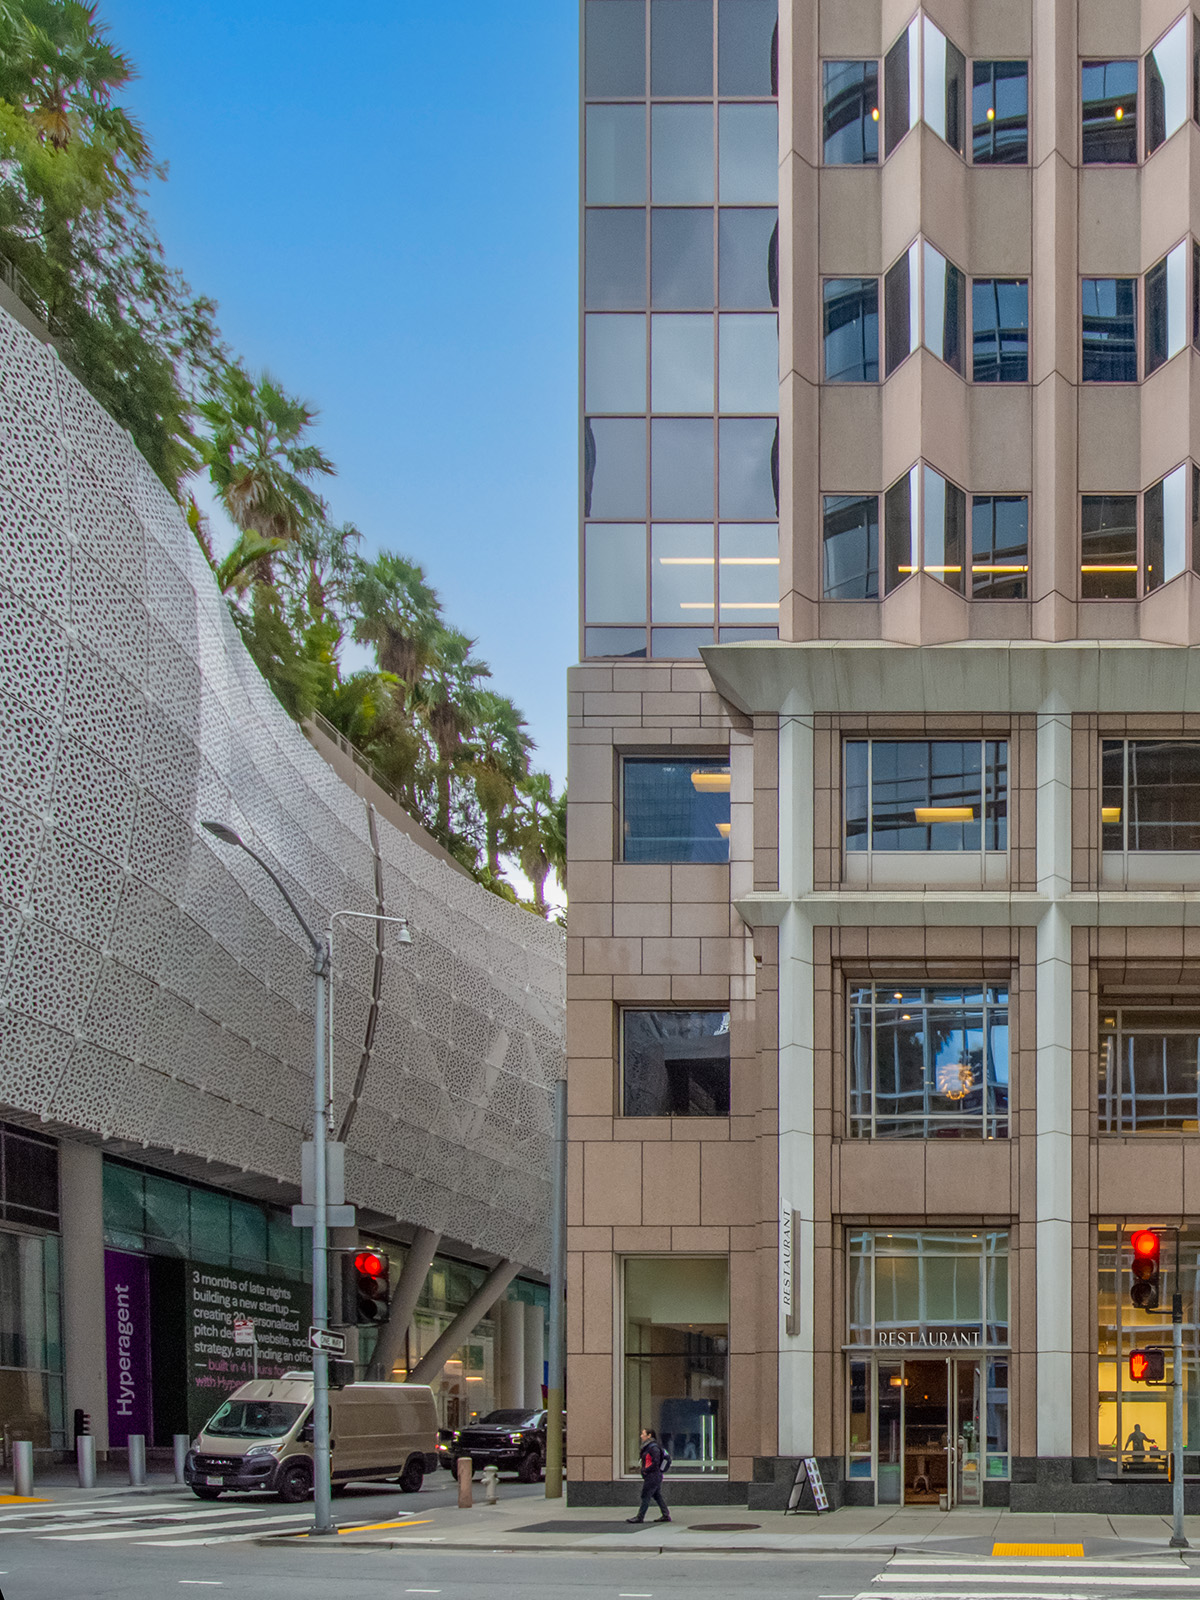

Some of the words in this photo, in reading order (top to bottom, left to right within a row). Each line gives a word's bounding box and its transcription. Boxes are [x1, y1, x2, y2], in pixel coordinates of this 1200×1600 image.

[783, 1209, 791, 1306] RESTAURANT
[192, 1270, 200, 1283] 3
[201, 1274, 238, 1290] months
[238, 1280, 249, 1292] of
[249, 1281, 266, 1295] late
[266, 1285, 292, 1300] nights
[193, 1288, 231, 1308] building
[232, 1298, 238, 1307] a
[239, 1299, 258, 1310] new
[258, 1300, 290, 1316] startup
[193, 1308, 232, 1325] creating
[194, 1323, 219, 1338] pitch
[257, 1332, 291, 1347] website,
[292, 1337, 309, 1347] soci
[320, 1335, 331, 1346] ONE
[879, 1332, 980, 1347] RESTAURANT
[115, 1284, 135, 1416] Hyperagent
[194, 1343, 234, 1358] strategy,
[235, 1346, 253, 1357] and
[283, 1353, 294, 1362] an
[294, 1352, 314, 1363] offic
[208, 1358, 229, 1371] built
[229, 1360, 239, 1372] in
[240, 1361, 246, 1372] 4
[248, 1361, 272, 1375] hurs
[195, 1375, 216, 1388] with
